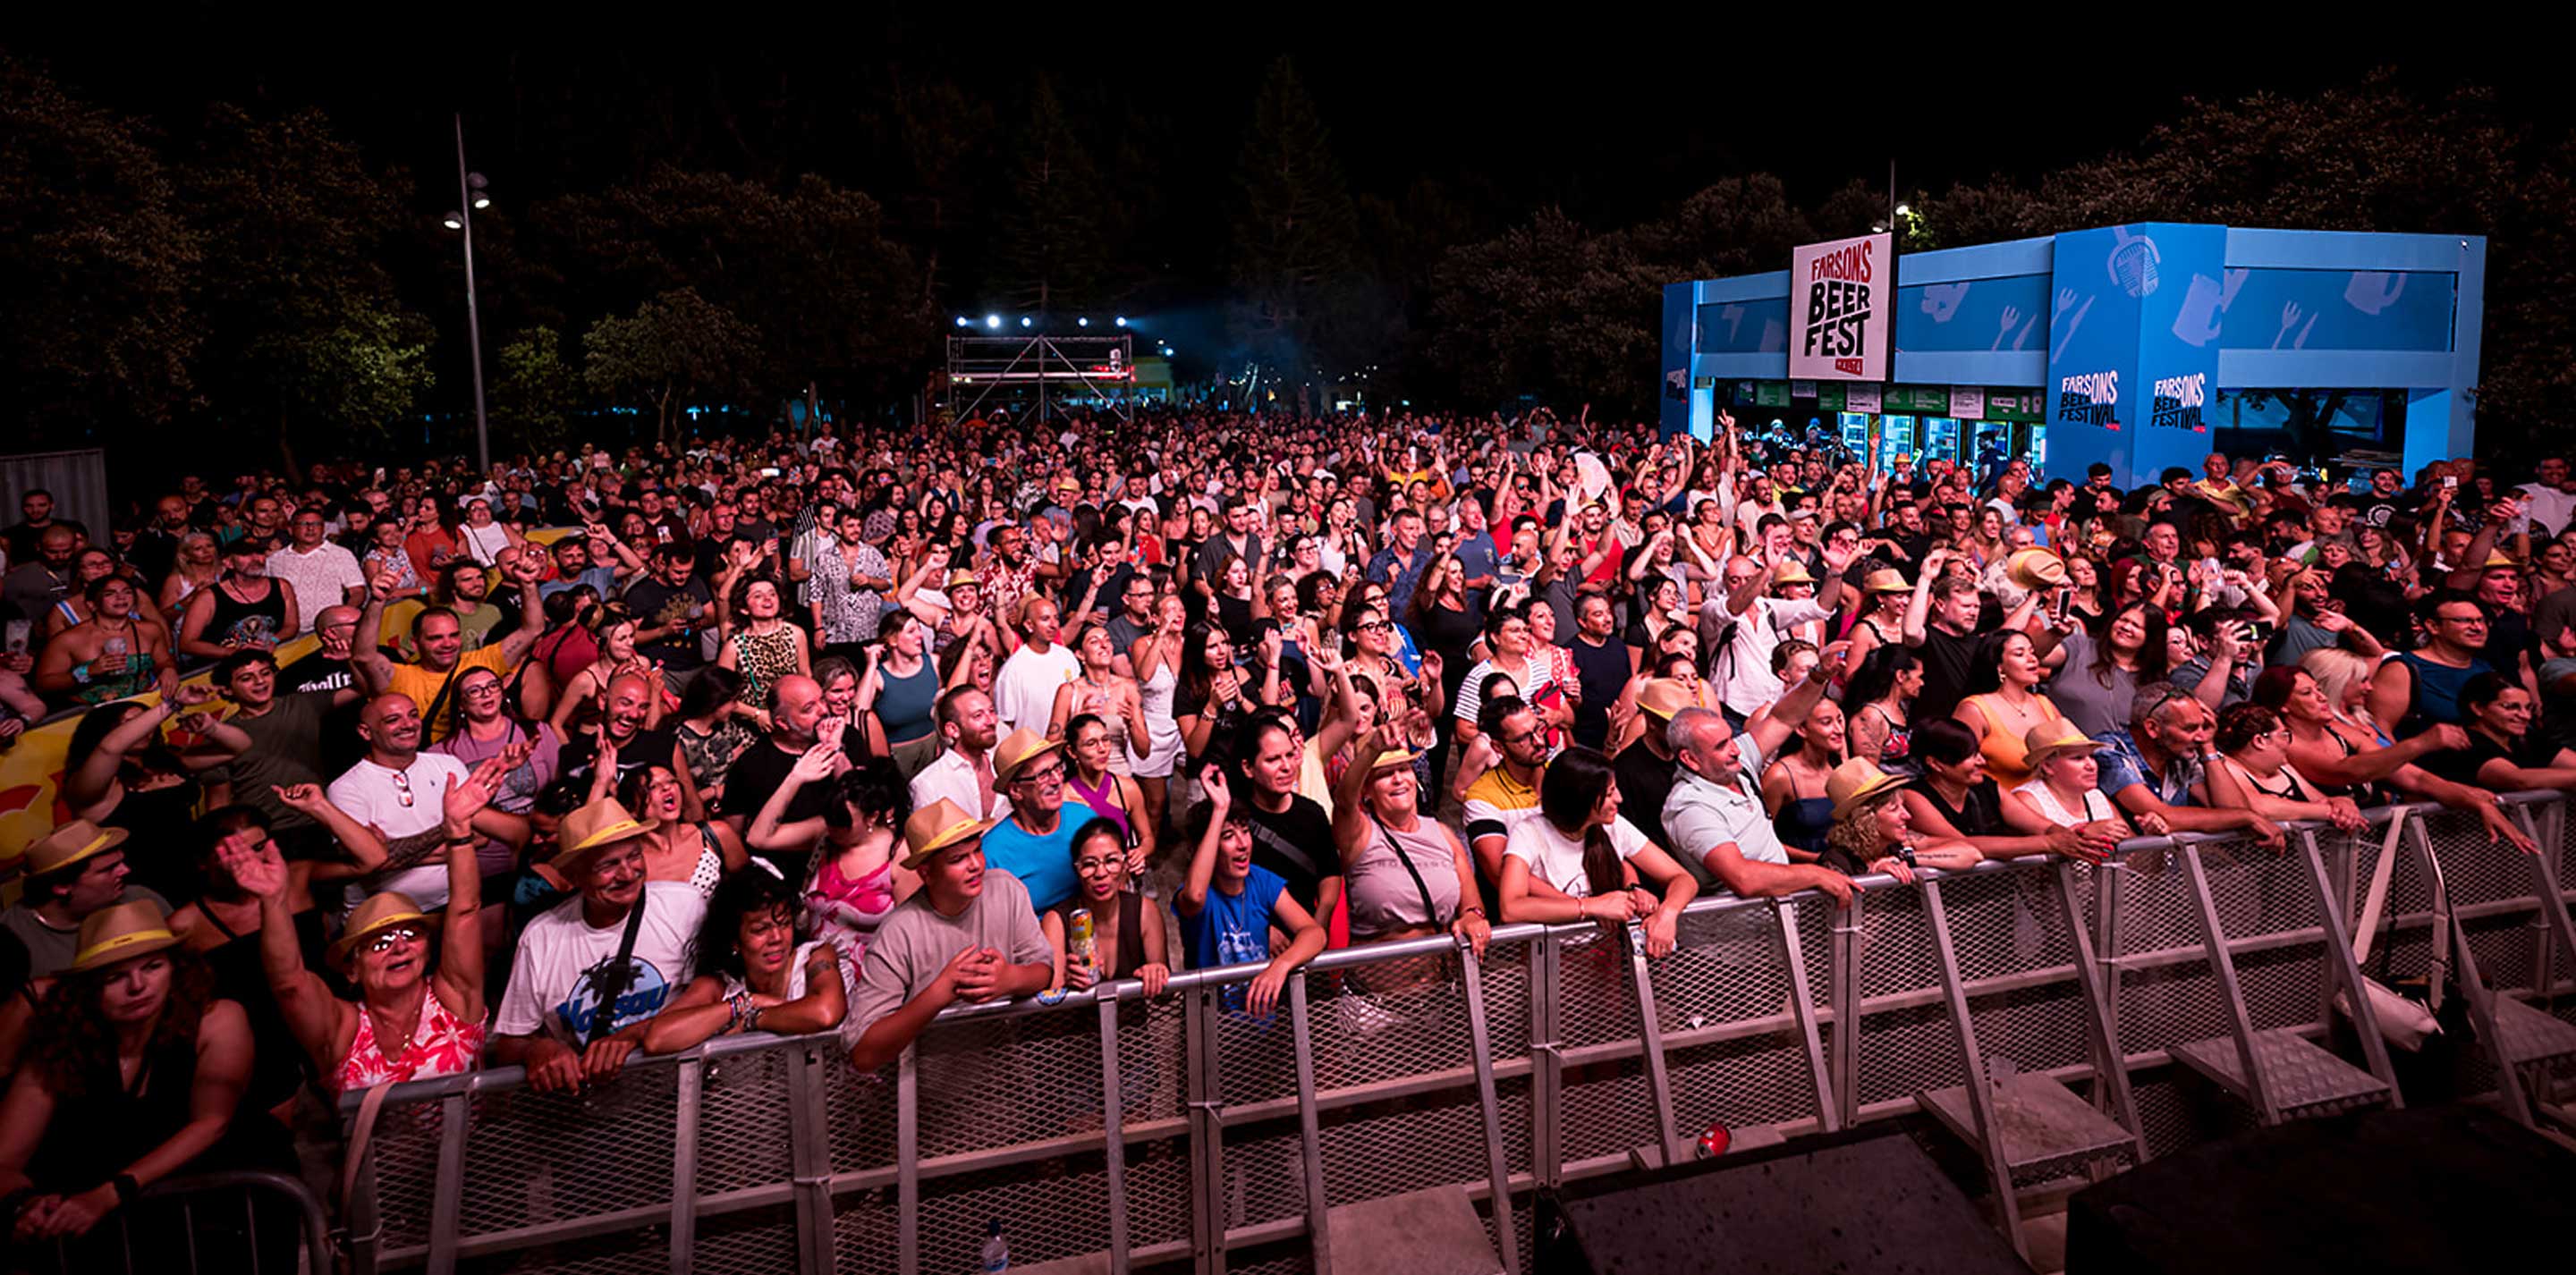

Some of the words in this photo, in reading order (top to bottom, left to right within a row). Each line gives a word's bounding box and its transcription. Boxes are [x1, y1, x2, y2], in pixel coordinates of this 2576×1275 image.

[1811, 240, 1872, 283] FARSONS
[1808, 280, 1870, 325] BEER
[1804, 309, 1870, 357] FEST
[2060, 392, 2091, 408] BEER
[2062, 369, 2119, 404] FARSONS
[2154, 372, 2206, 408] FARSONS
[2059, 403, 2120, 427] FESTIVAL
[2151, 407, 2206, 430] FESTIVAL
[2154, 396, 2182, 413] BEER
